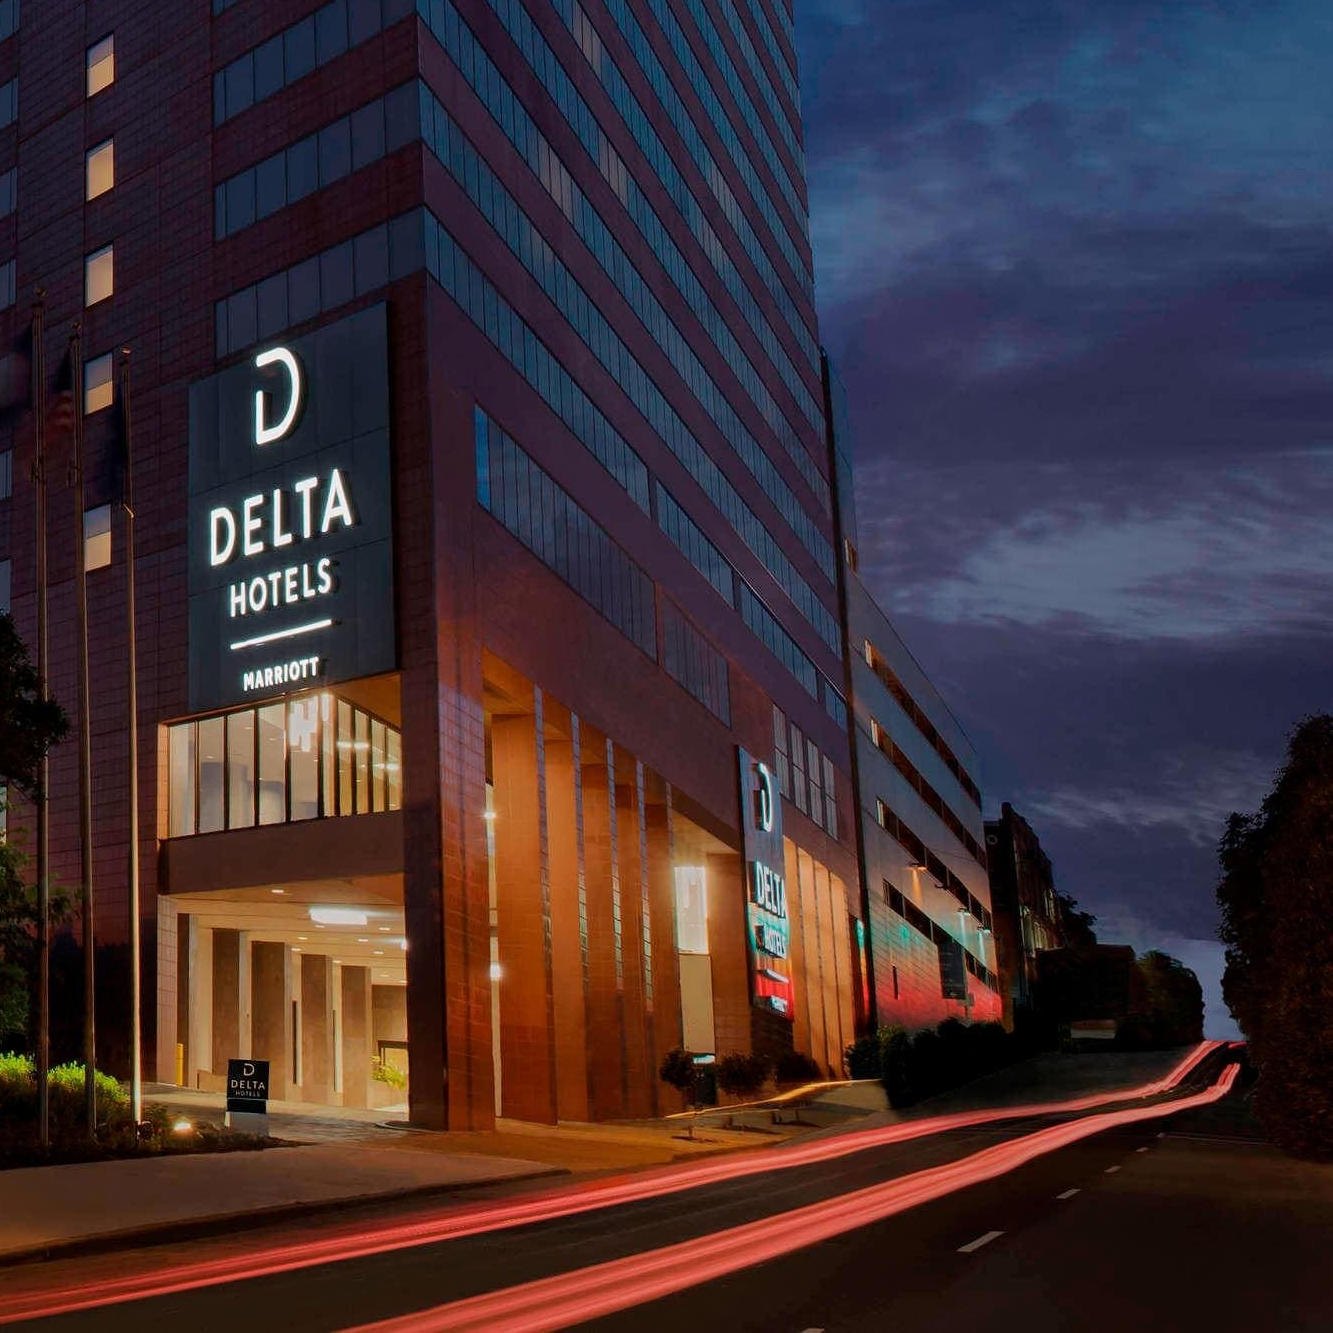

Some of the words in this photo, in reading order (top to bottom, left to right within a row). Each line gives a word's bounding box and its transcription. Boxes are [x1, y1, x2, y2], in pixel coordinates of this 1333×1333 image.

[256, 346, 300, 446] D
[211, 468, 353, 566] DELTA
[230, 558, 333, 618] HOTELS
[243, 656, 320, 692] MARRIOTT
[755, 858, 787, 918] DELTA
[231, 1079, 265, 1090] DELTA
[243, 1063, 255, 1076] D
